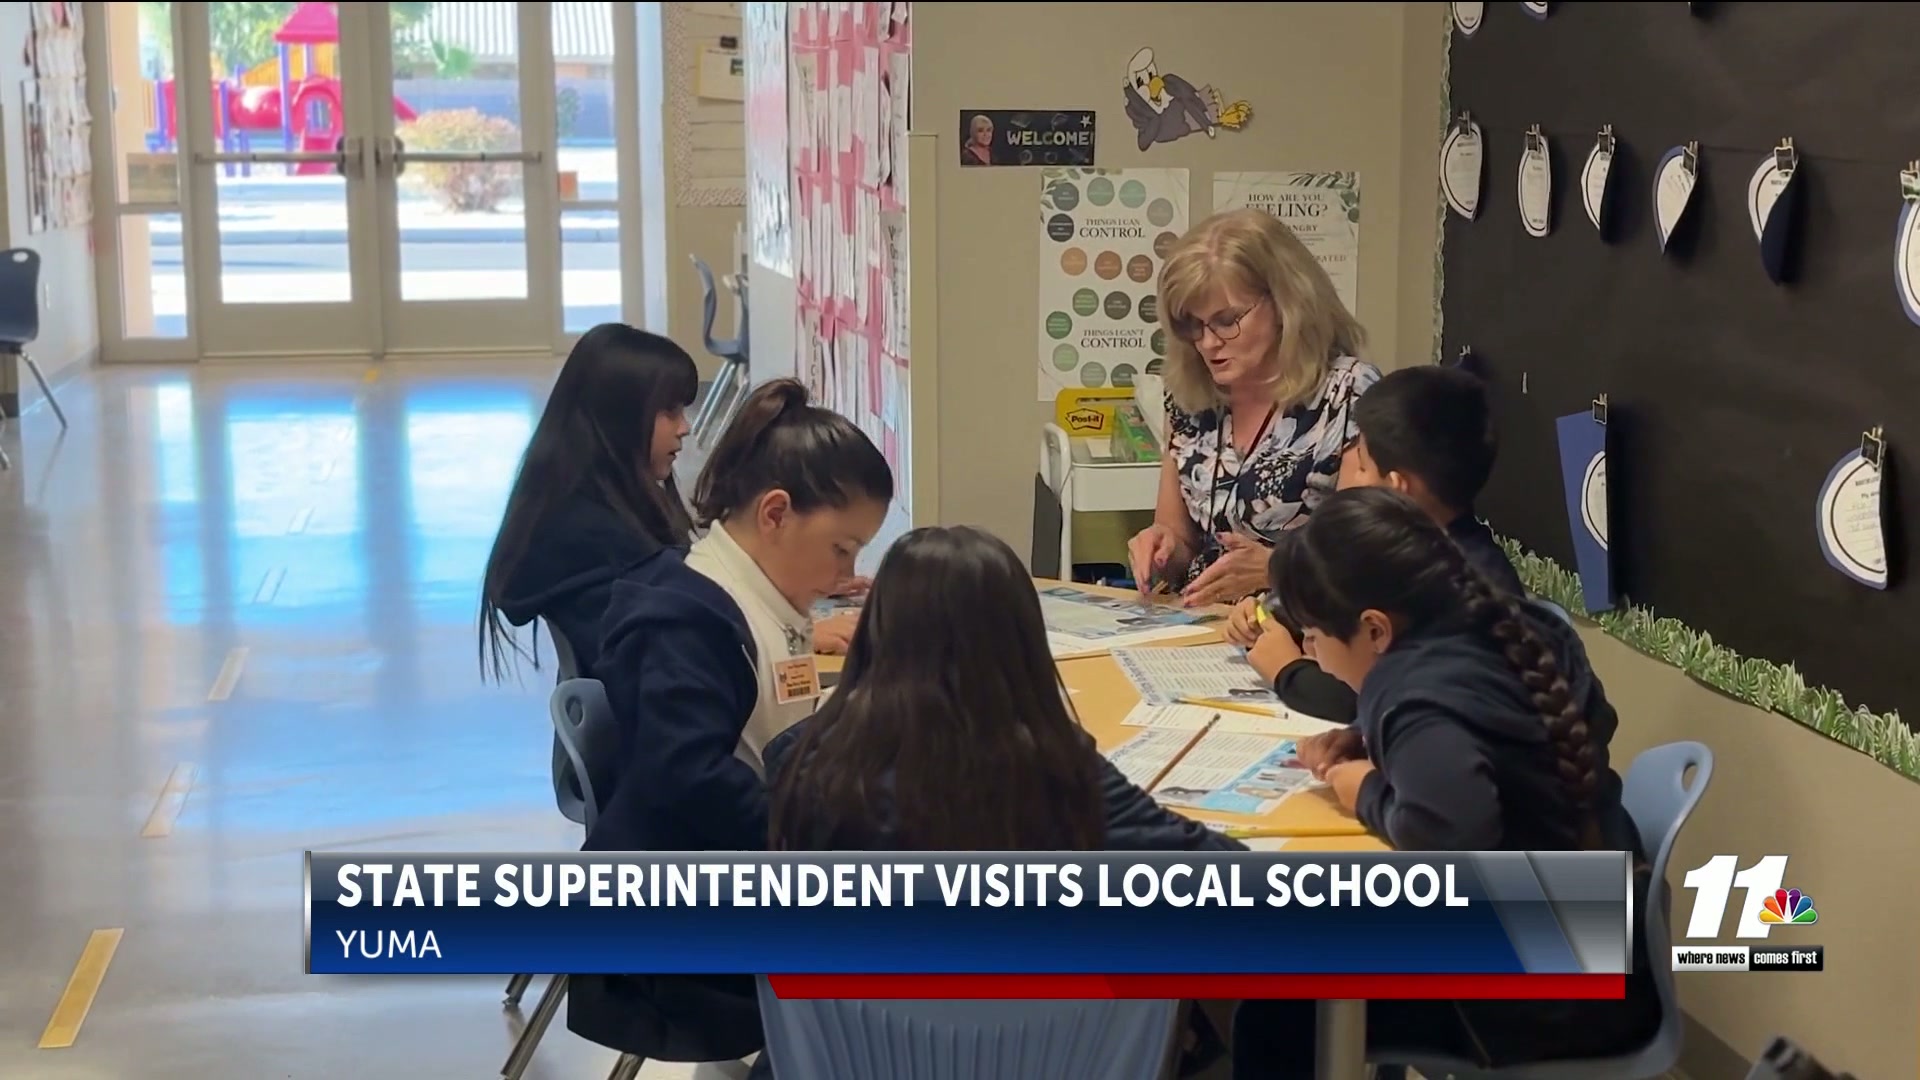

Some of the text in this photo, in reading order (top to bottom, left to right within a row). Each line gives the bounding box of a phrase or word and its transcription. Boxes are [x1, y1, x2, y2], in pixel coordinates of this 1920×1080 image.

[1006, 130, 1094, 146] WELCOME!
[1248, 193, 1325, 202] HOW ARE YOU
[1085, 218, 1117, 226] THINGS
[1079, 227, 1146, 238] CONTROL
[1083, 329, 1114, 337] THINGS
[1080, 338, 1146, 348] CONTROL
[1071, 415, 1100, 424] Post-it
